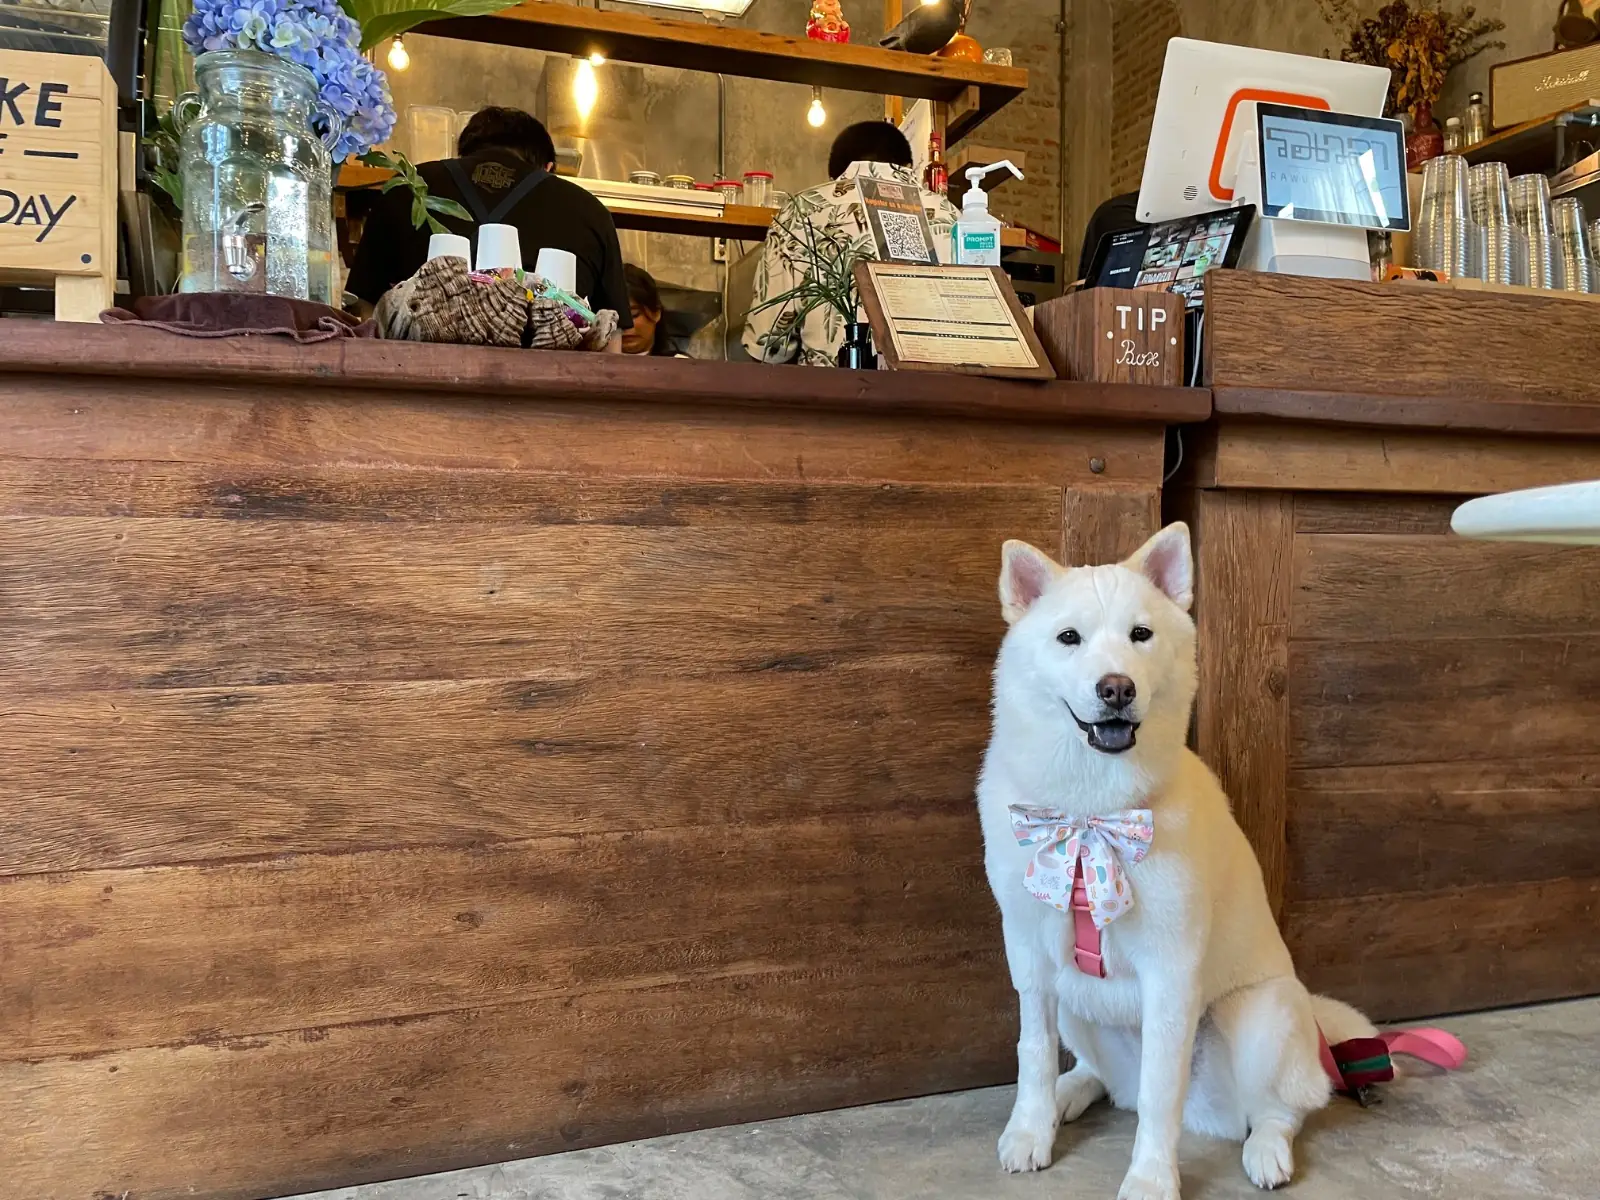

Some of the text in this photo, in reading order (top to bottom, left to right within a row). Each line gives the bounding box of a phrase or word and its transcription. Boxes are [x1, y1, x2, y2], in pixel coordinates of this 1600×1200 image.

[0, 77, 69, 128] KE
[1115, 305, 1167, 332] TIP
[1115, 339, 1160, 367] Box
